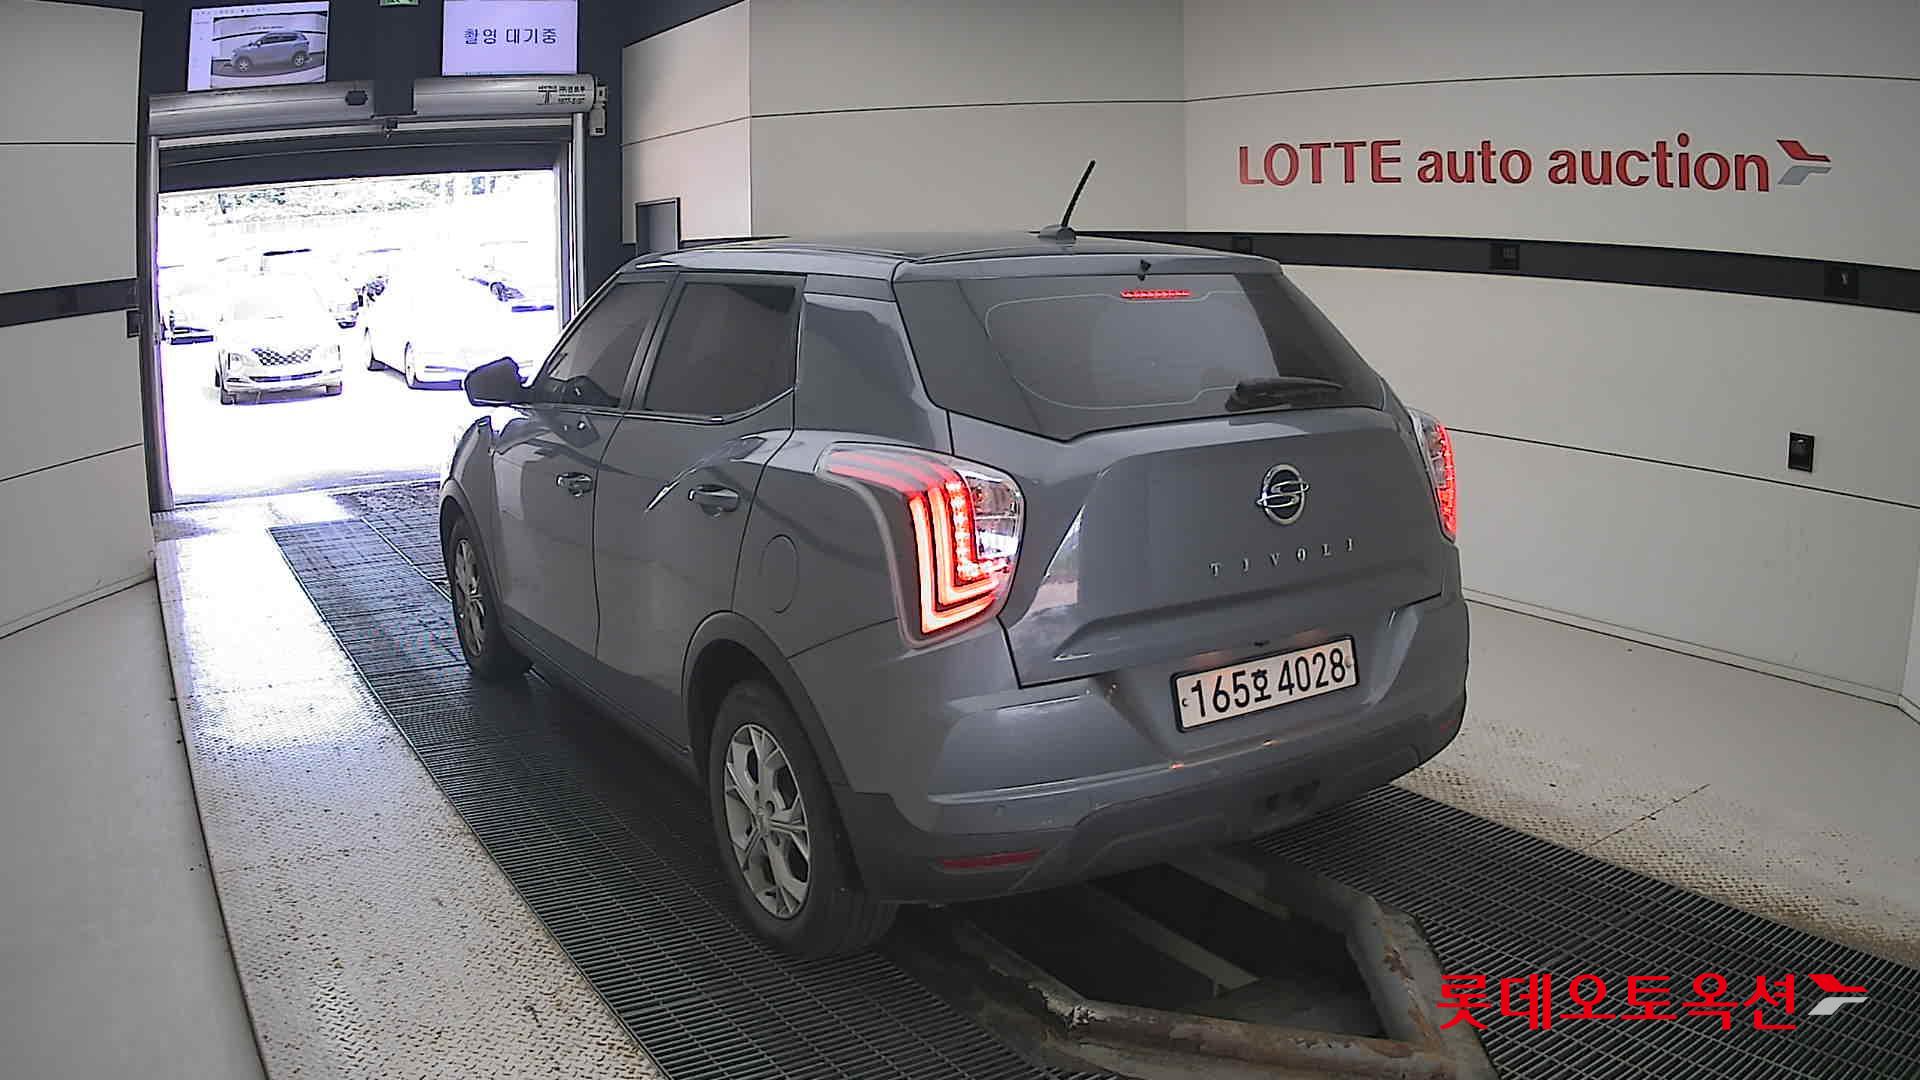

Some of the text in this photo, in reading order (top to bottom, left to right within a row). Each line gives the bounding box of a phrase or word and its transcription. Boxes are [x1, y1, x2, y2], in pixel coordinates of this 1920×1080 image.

[505, 28, 557, 45] 대기중
[1239, 132, 1770, 192] LOTTE auto auction
[1209, 537, 1355, 577] TIVOLI
[1190, 647, 1347, 719] 165호 4028
